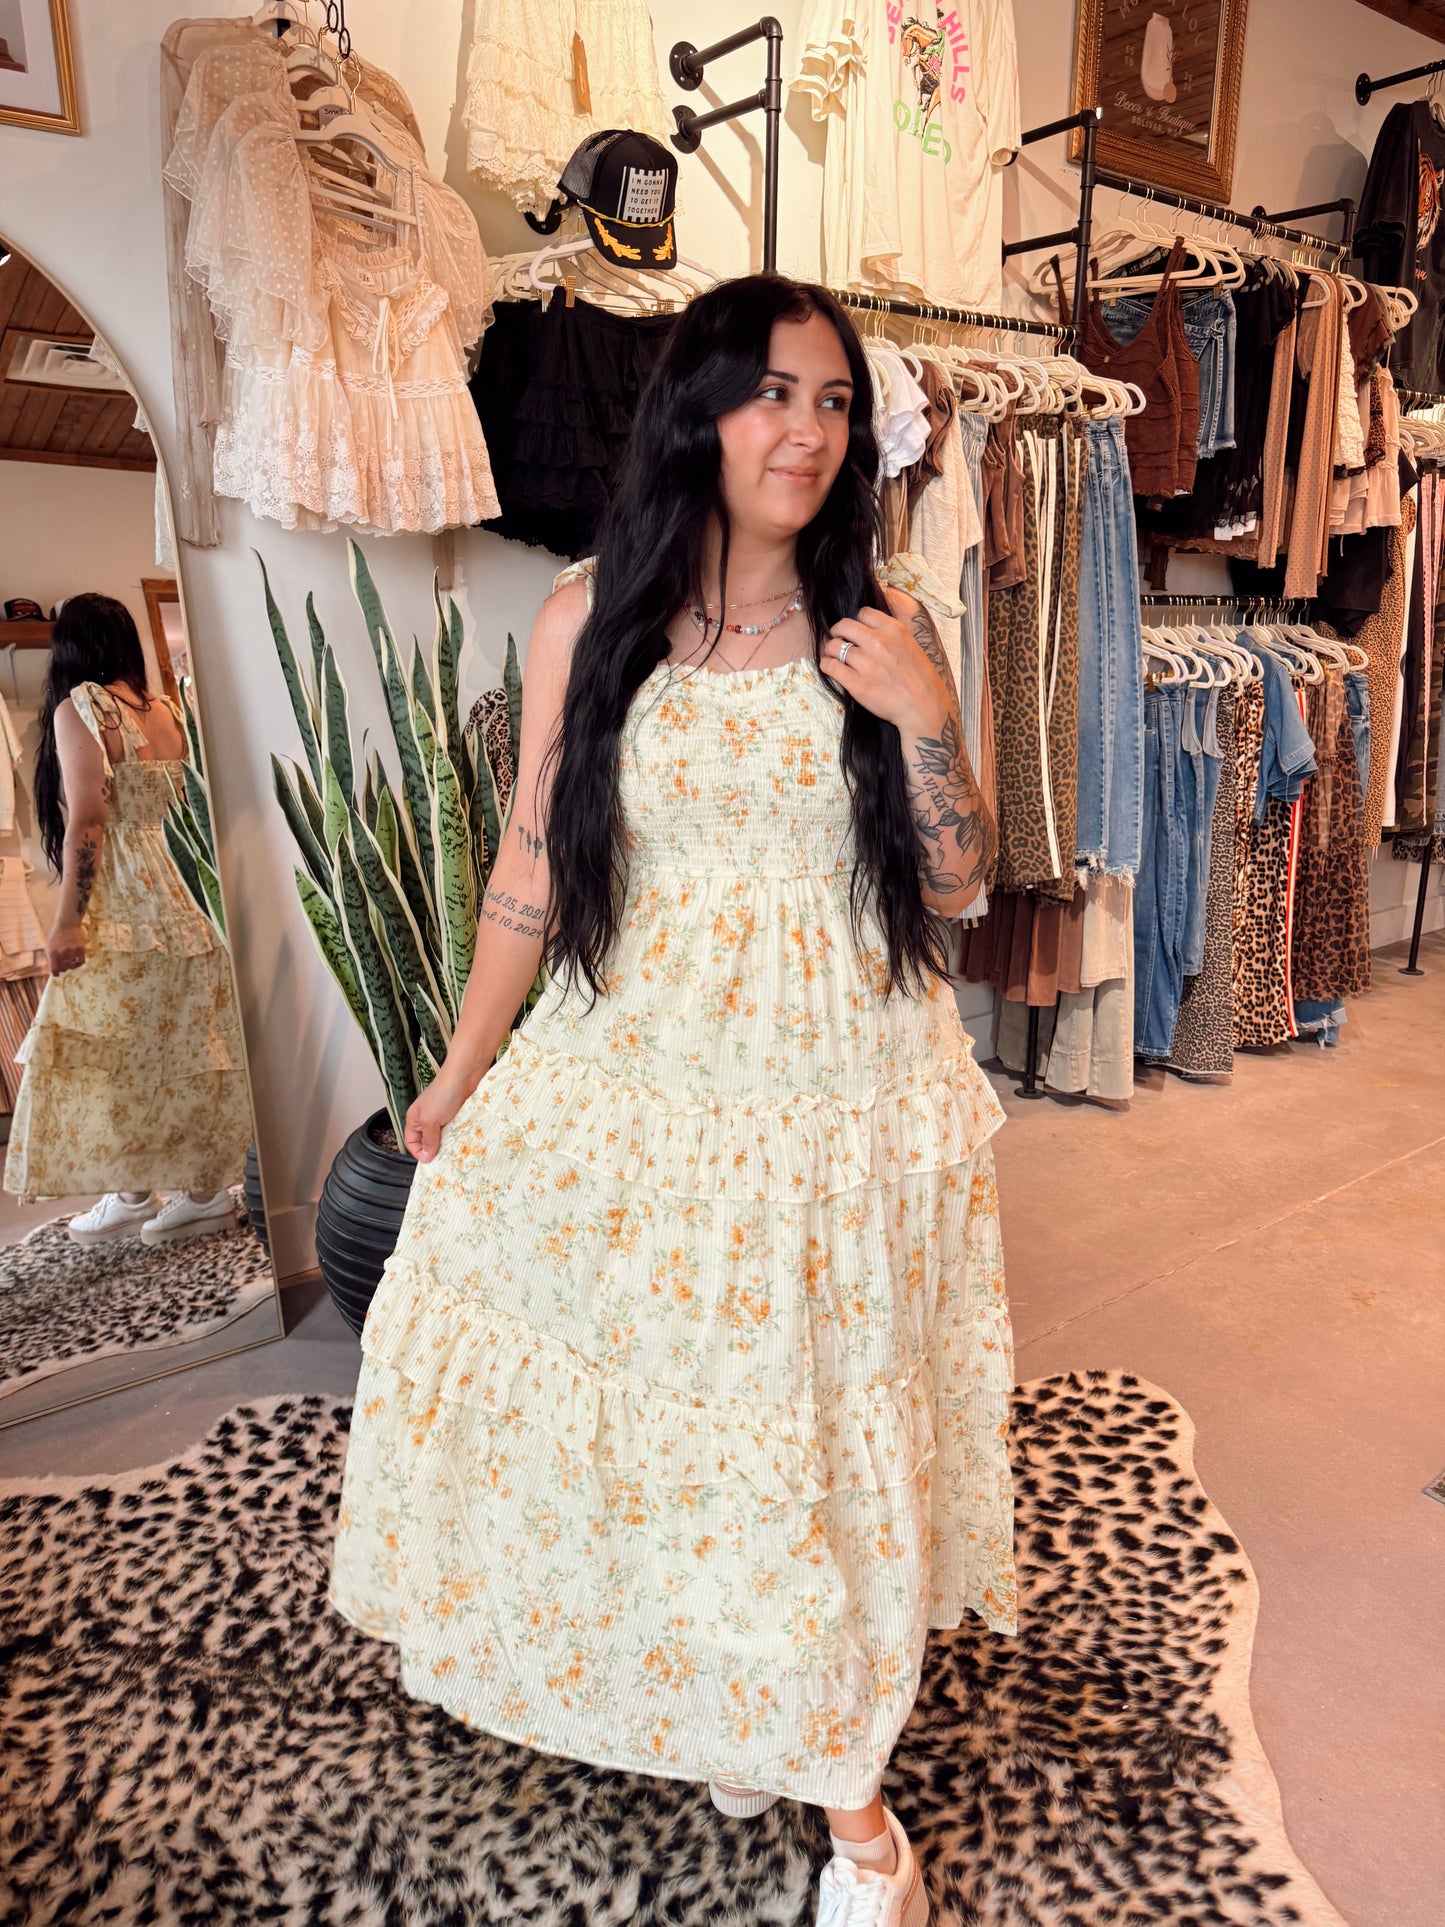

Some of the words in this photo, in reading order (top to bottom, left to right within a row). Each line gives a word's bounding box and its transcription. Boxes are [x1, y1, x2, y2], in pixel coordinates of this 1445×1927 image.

[943, 10, 970, 104] HILLS
[1156, 105, 1196, 135] Boutique
[644, 178, 663, 186] GONNA
[630, 187, 649, 195] NEED
[651, 188, 661, 196] YOU
[627, 206, 658, 214] TOGETHER
[502, 896, 518, 912] 25,
[518, 904, 545, 920] 2021
[498, 915, 513, 930] 10,
